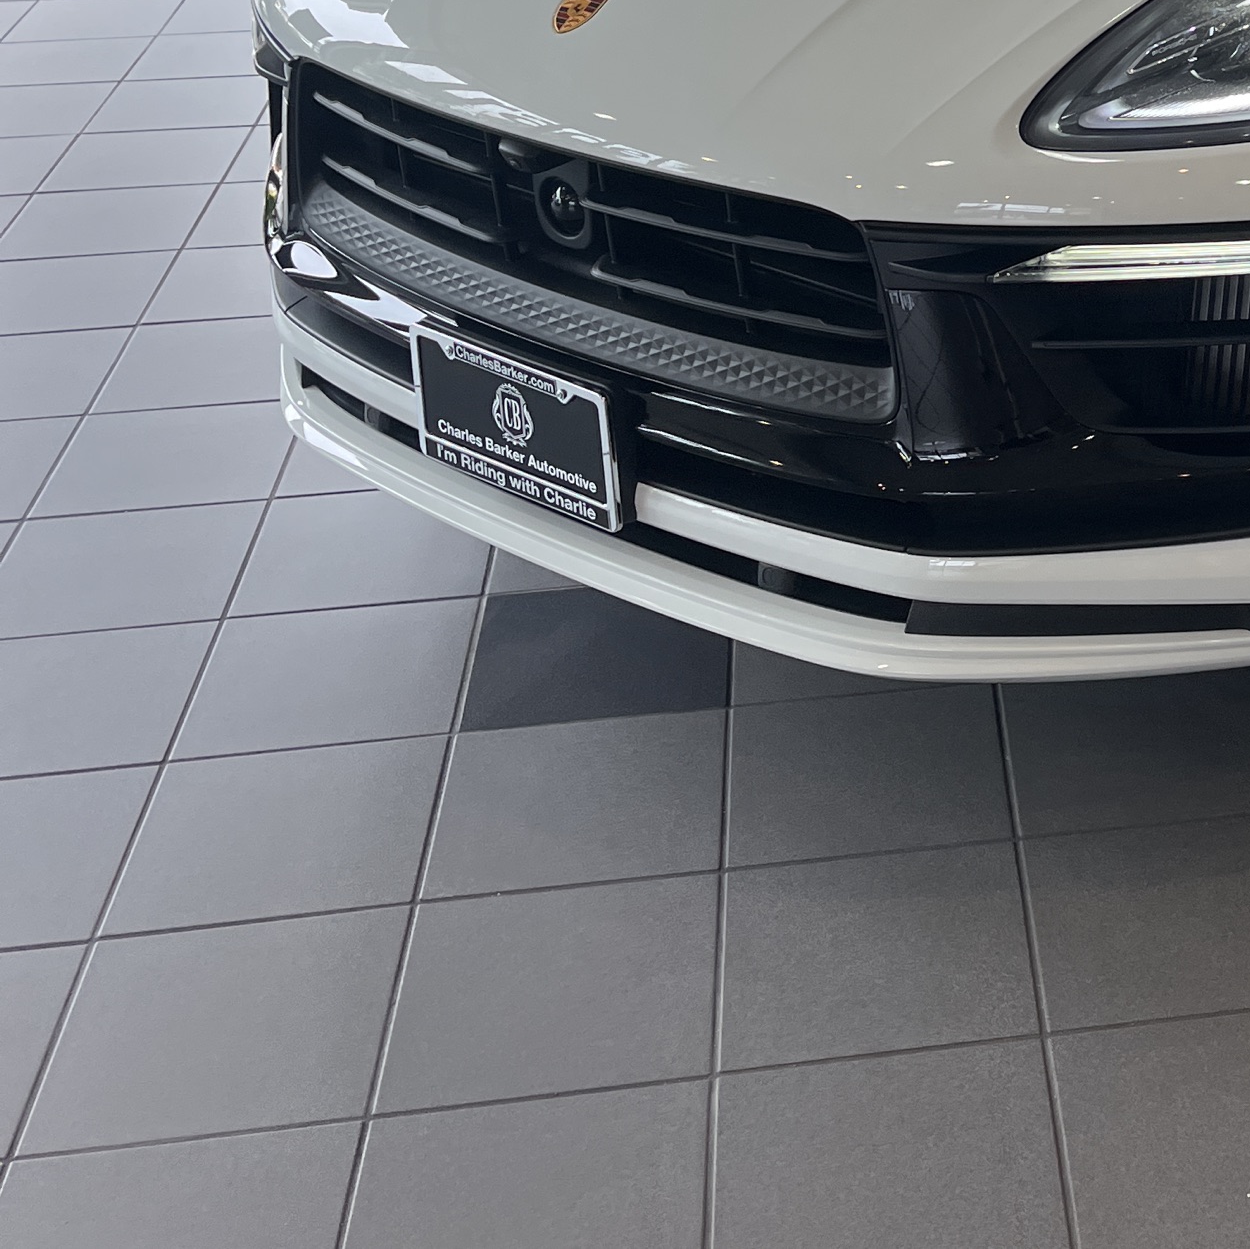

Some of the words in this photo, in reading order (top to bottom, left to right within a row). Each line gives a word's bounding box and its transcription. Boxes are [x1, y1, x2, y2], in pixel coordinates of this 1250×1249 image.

[455, 345, 555, 393] CharlesBarker.com
[436, 443, 457, 464] I'm
[460, 452, 506, 487] Riding
[509, 470, 540, 498] with
[543, 487, 597, 520] Charlie
[438, 419, 483, 447] Charles
[485, 436, 525, 464] Barker
[527, 451, 597, 493] Automotive
